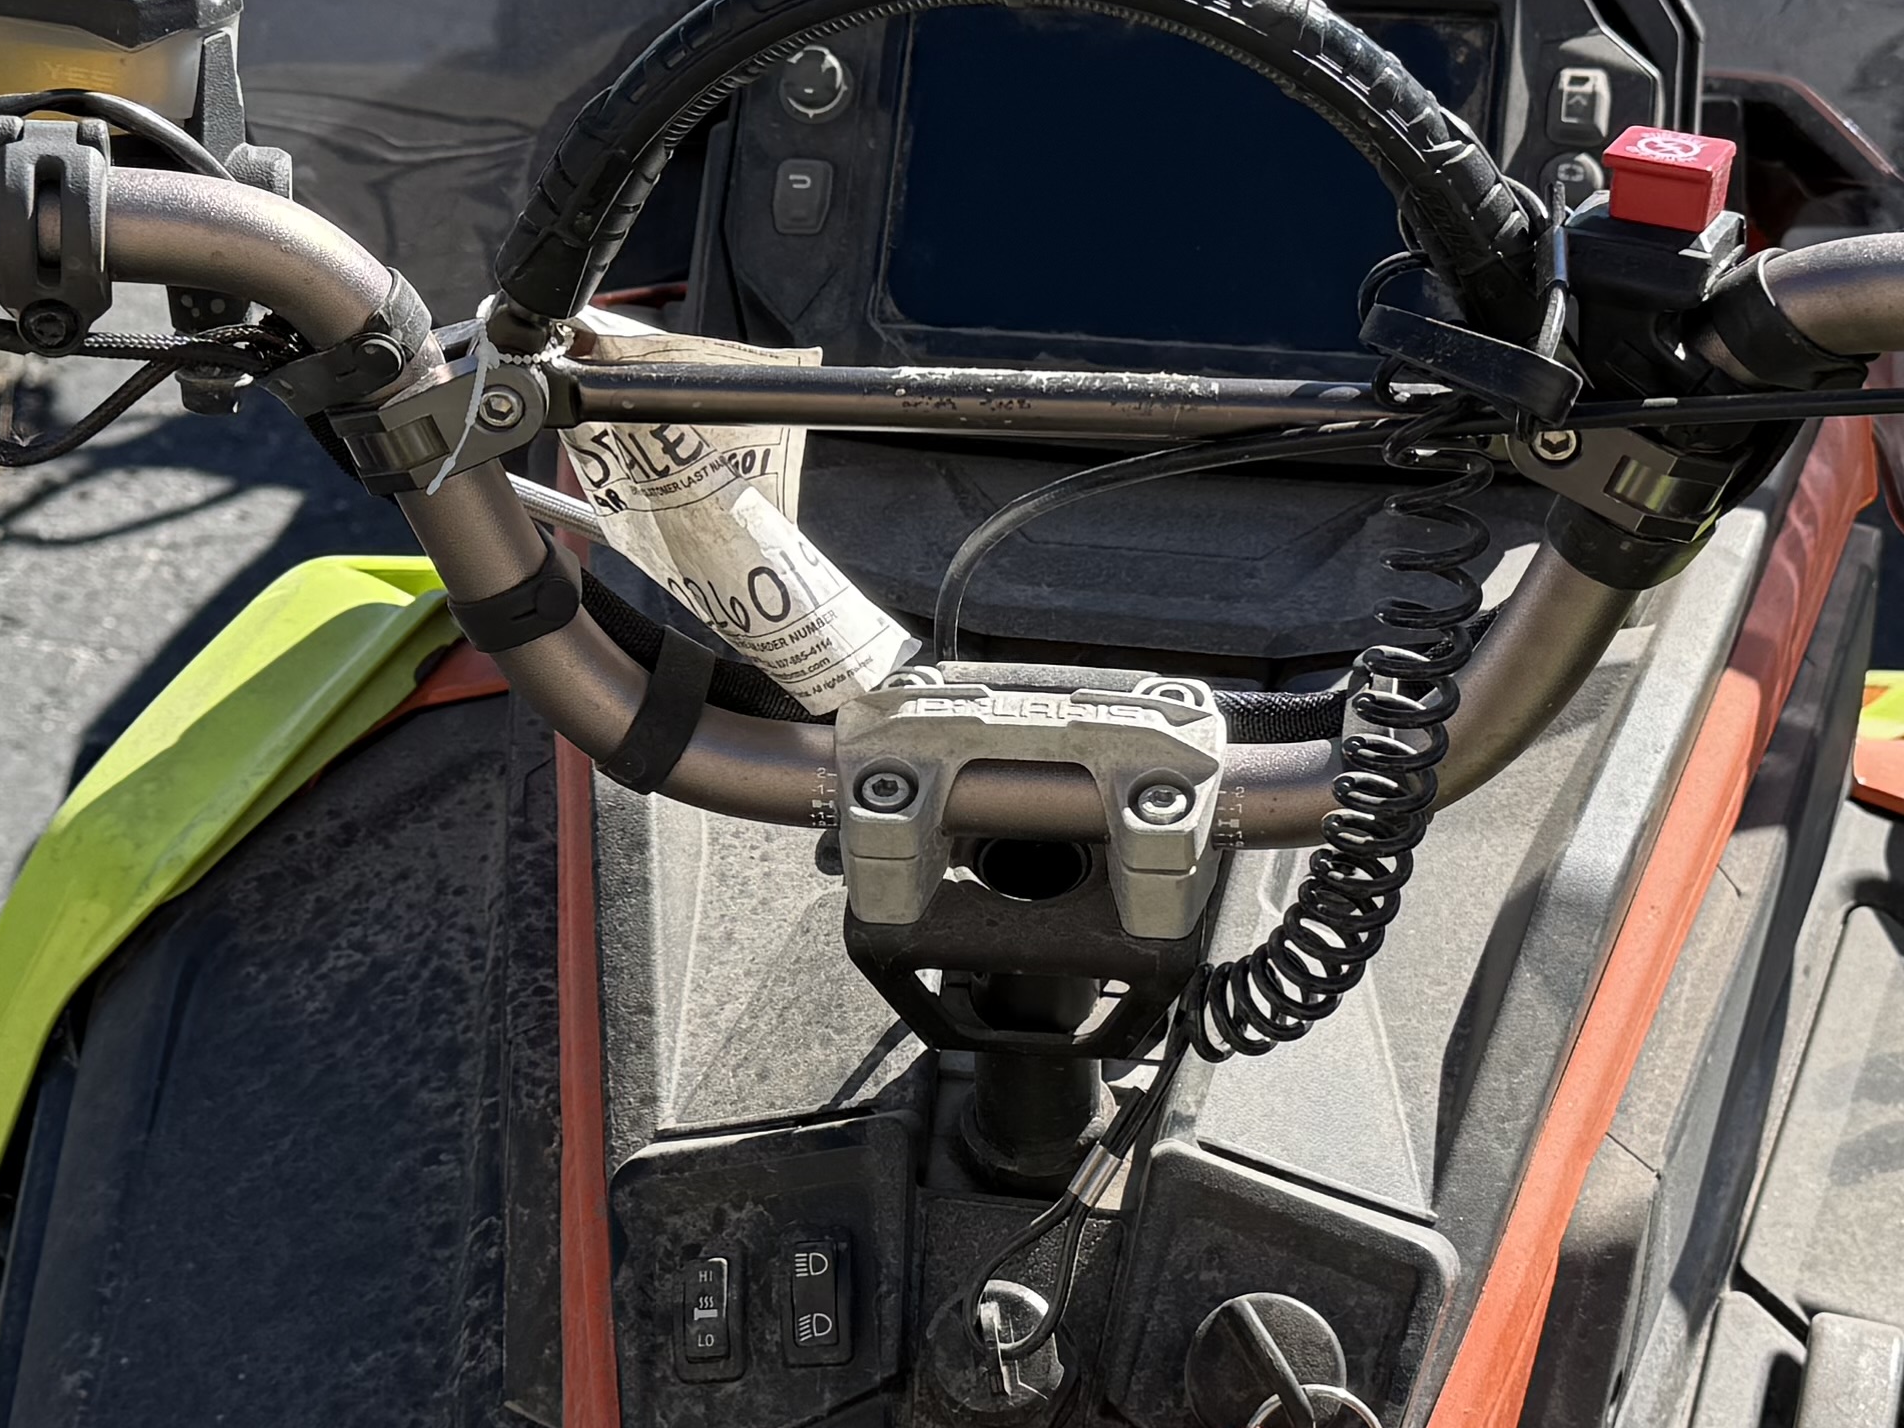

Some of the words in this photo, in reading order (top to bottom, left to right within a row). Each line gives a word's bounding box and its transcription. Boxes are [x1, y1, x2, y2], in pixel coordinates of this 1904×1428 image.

[680, 466, 710, 489] LAST
[790, 610, 838, 643] NUMBER
[698, 1270, 713, 1283] HI
[698, 1334, 715, 1347] LO
